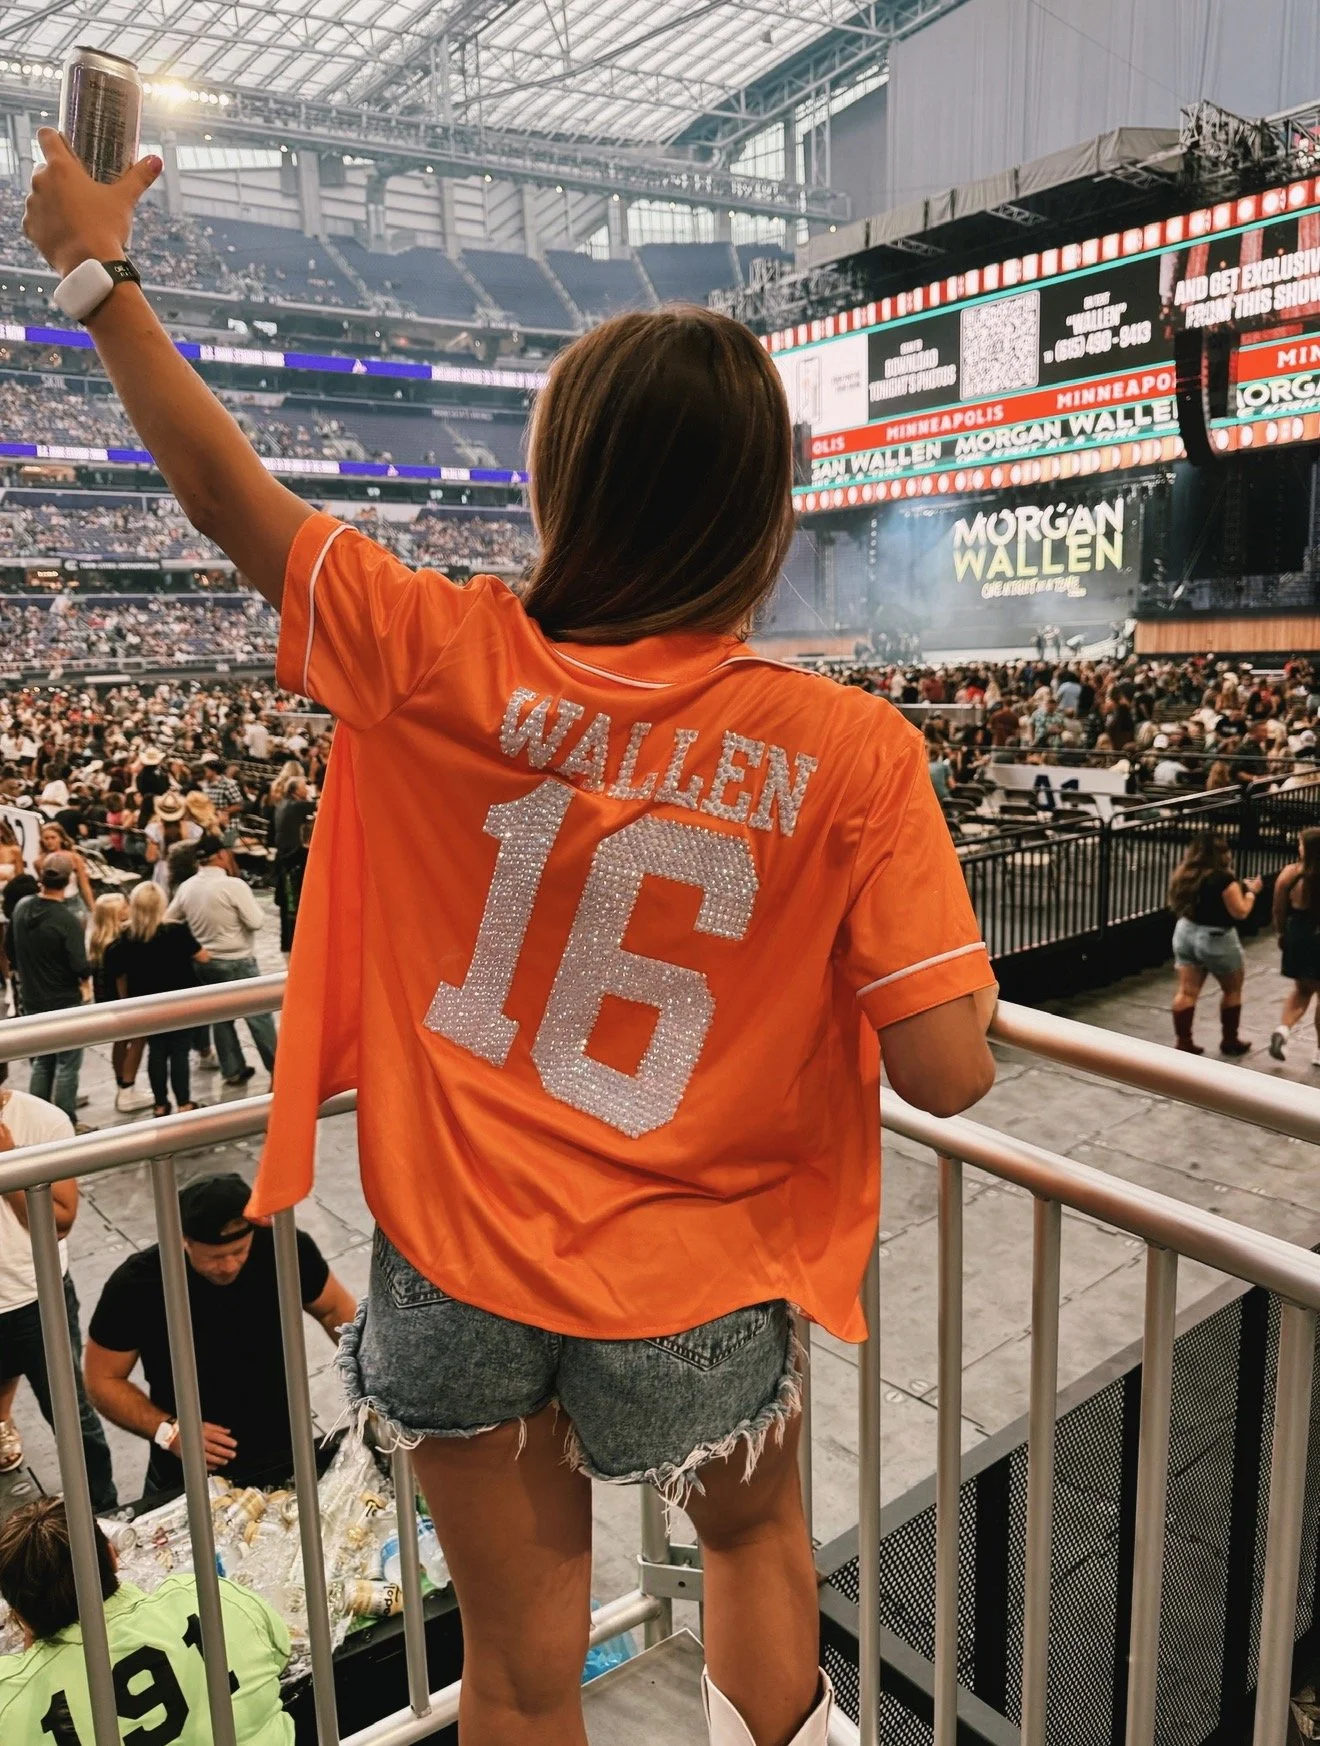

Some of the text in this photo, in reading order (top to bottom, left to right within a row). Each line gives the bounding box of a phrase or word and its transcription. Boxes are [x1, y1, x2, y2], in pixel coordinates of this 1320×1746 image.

[1174, 275, 1208, 306] AND
[1209, 267, 1240, 297] GET
[1185, 276, 1320, 329] FROM THIS SHOW
[1056, 370, 1176, 409] MINNEAPO
[886, 404, 1004, 441] MINNEAPOLIS
[955, 400, 1179, 456] MORGAN WALLE
[850, 440, 942, 475] WALLEN
[953, 497, 1124, 549] MORGAN
[953, 530, 1124, 583] WALLEN
[499, 686, 818, 837] WALLEN
[422, 777, 760, 1138] 16
